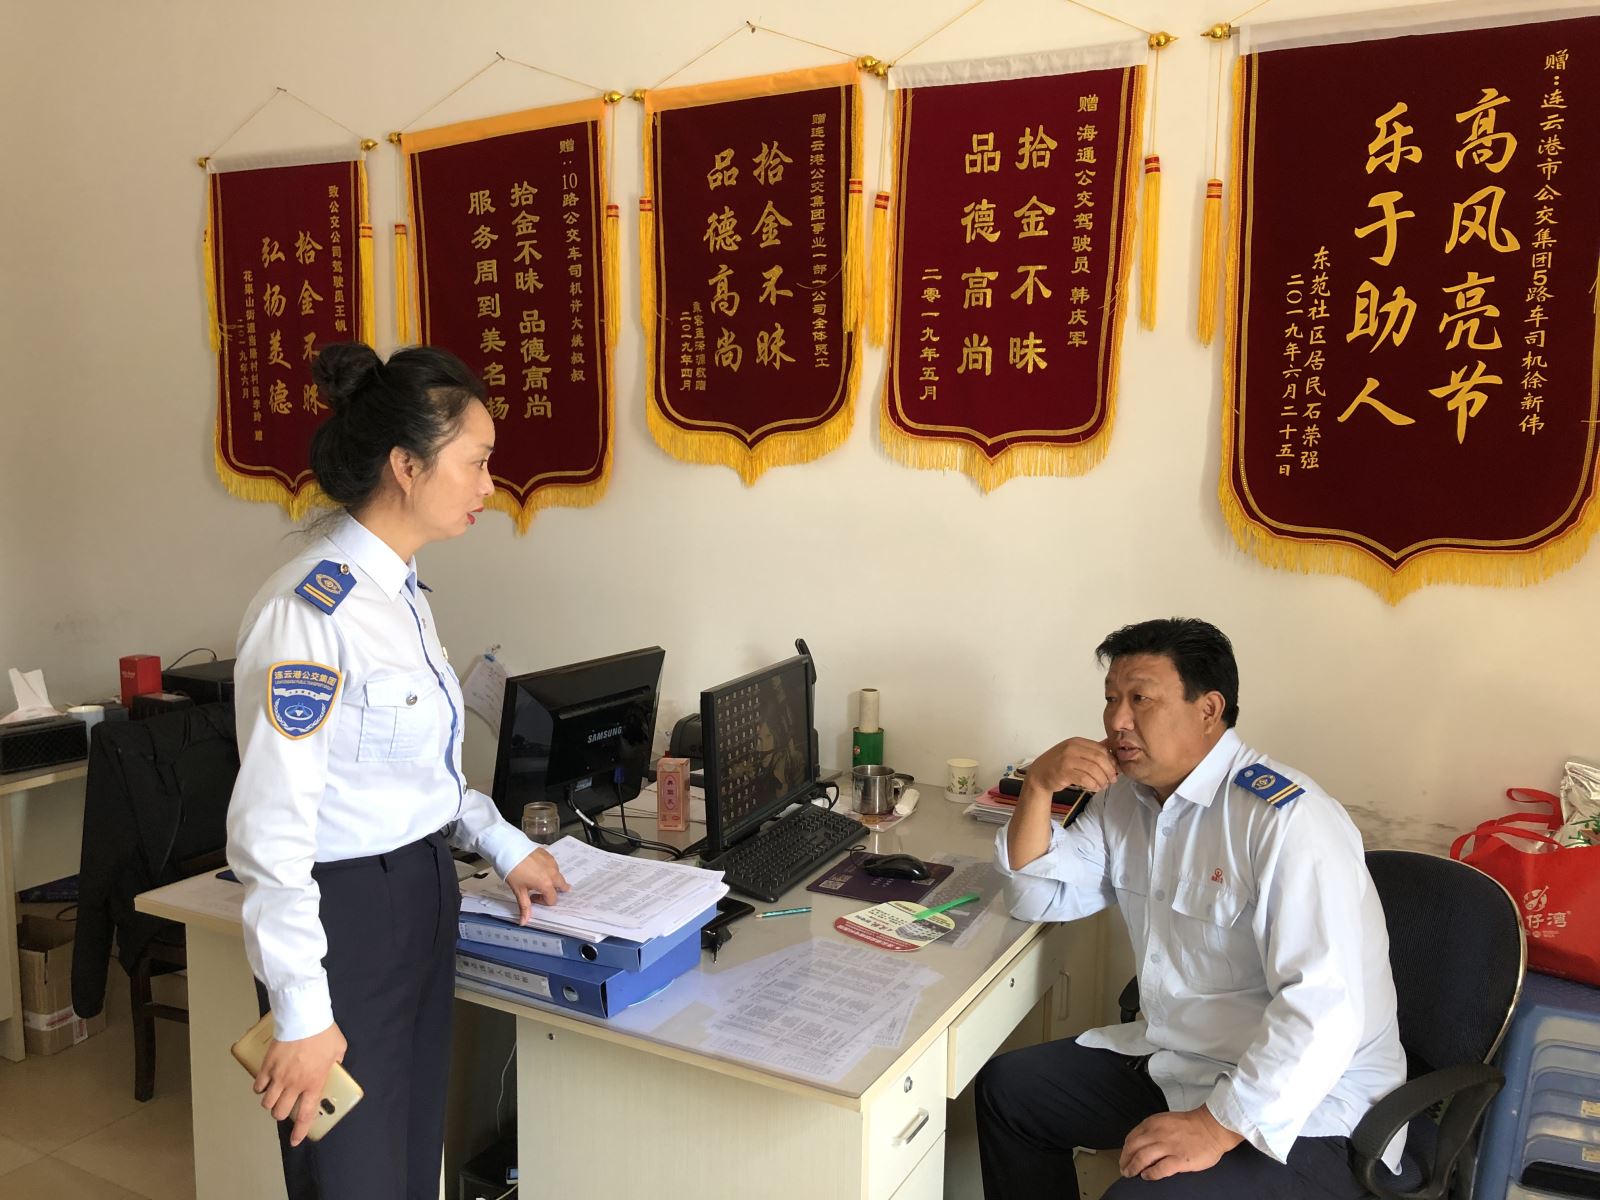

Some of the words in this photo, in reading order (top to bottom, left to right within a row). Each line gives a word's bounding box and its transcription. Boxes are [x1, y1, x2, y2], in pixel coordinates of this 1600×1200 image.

[261, 236, 293, 415] 弘扬美德
[295, 230, 329, 417] 拾金不昧
[468, 189, 509, 420] 服务周到美名扬
[510, 180, 545, 294] 拾金不昧
[703, 148, 743, 373] 品德高尚
[751, 141, 797, 371] 拾金不昧
[920, 267, 943, 402] 二零一九年五月
[957, 131, 1002, 377] 品德高尚
[1008, 124, 1059, 375] 拾金不昧
[1067, 285, 1091, 348] 韩庆军
[1337, 101, 1423, 428] 乐于助人
[1428, 87, 1521, 445] 高风亮节
[519, 309, 553, 420] 品德高尚
[1299, 245, 1332, 471] 东苑社区居民石荣强
[274, 670, 338, 687] 连云港公交集团
[587, 726, 622, 743] SAMSUNG
